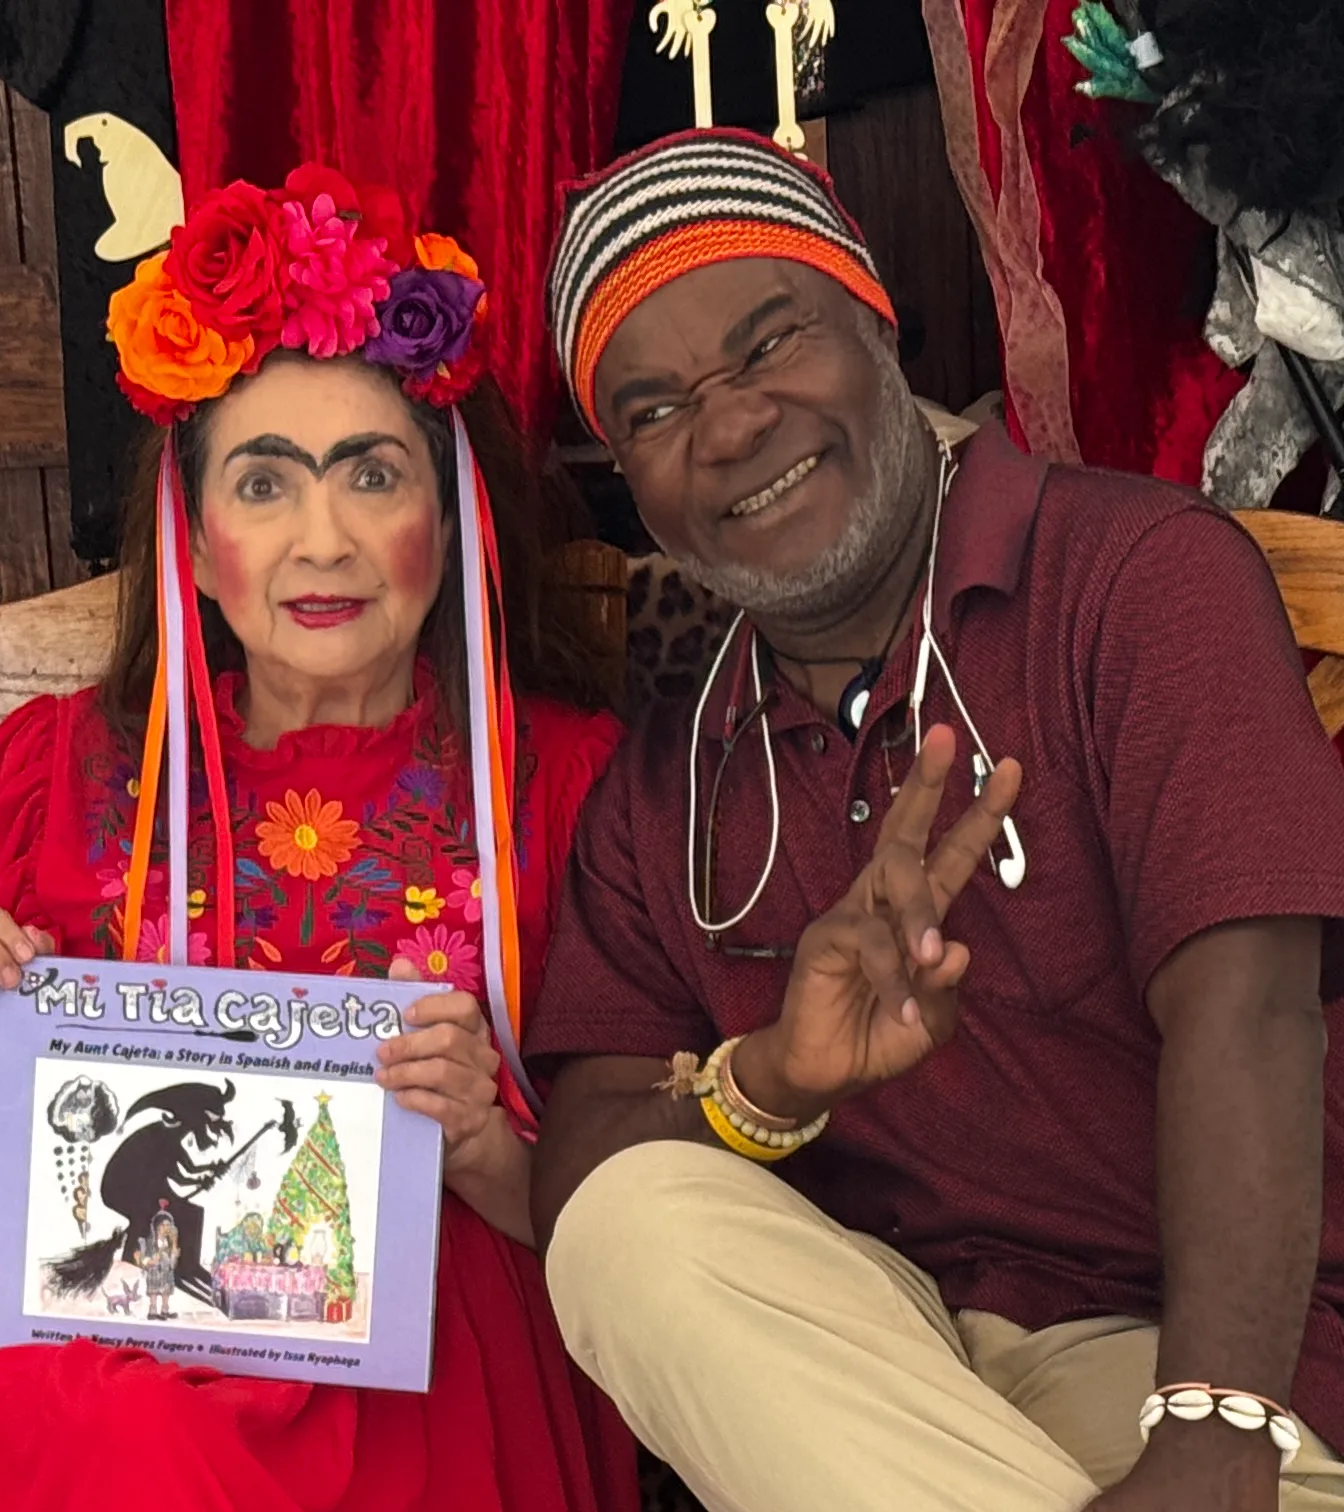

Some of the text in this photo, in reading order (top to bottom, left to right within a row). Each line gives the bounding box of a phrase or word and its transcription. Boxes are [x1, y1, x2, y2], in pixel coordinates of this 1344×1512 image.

[35, 974, 105, 1020] Mi
[116, 978, 209, 1028] Tia
[49, 1038, 374, 1076] My Aunt Cajeta: a Story in Spanish and English
[31, 1329, 73, 1341] Written
[92, 1333, 123, 1348] Nancy
[209, 1343, 266, 1359] Illustrated
[268, 1348, 282, 1362] by
[283, 1350, 305, 1362] Issa
